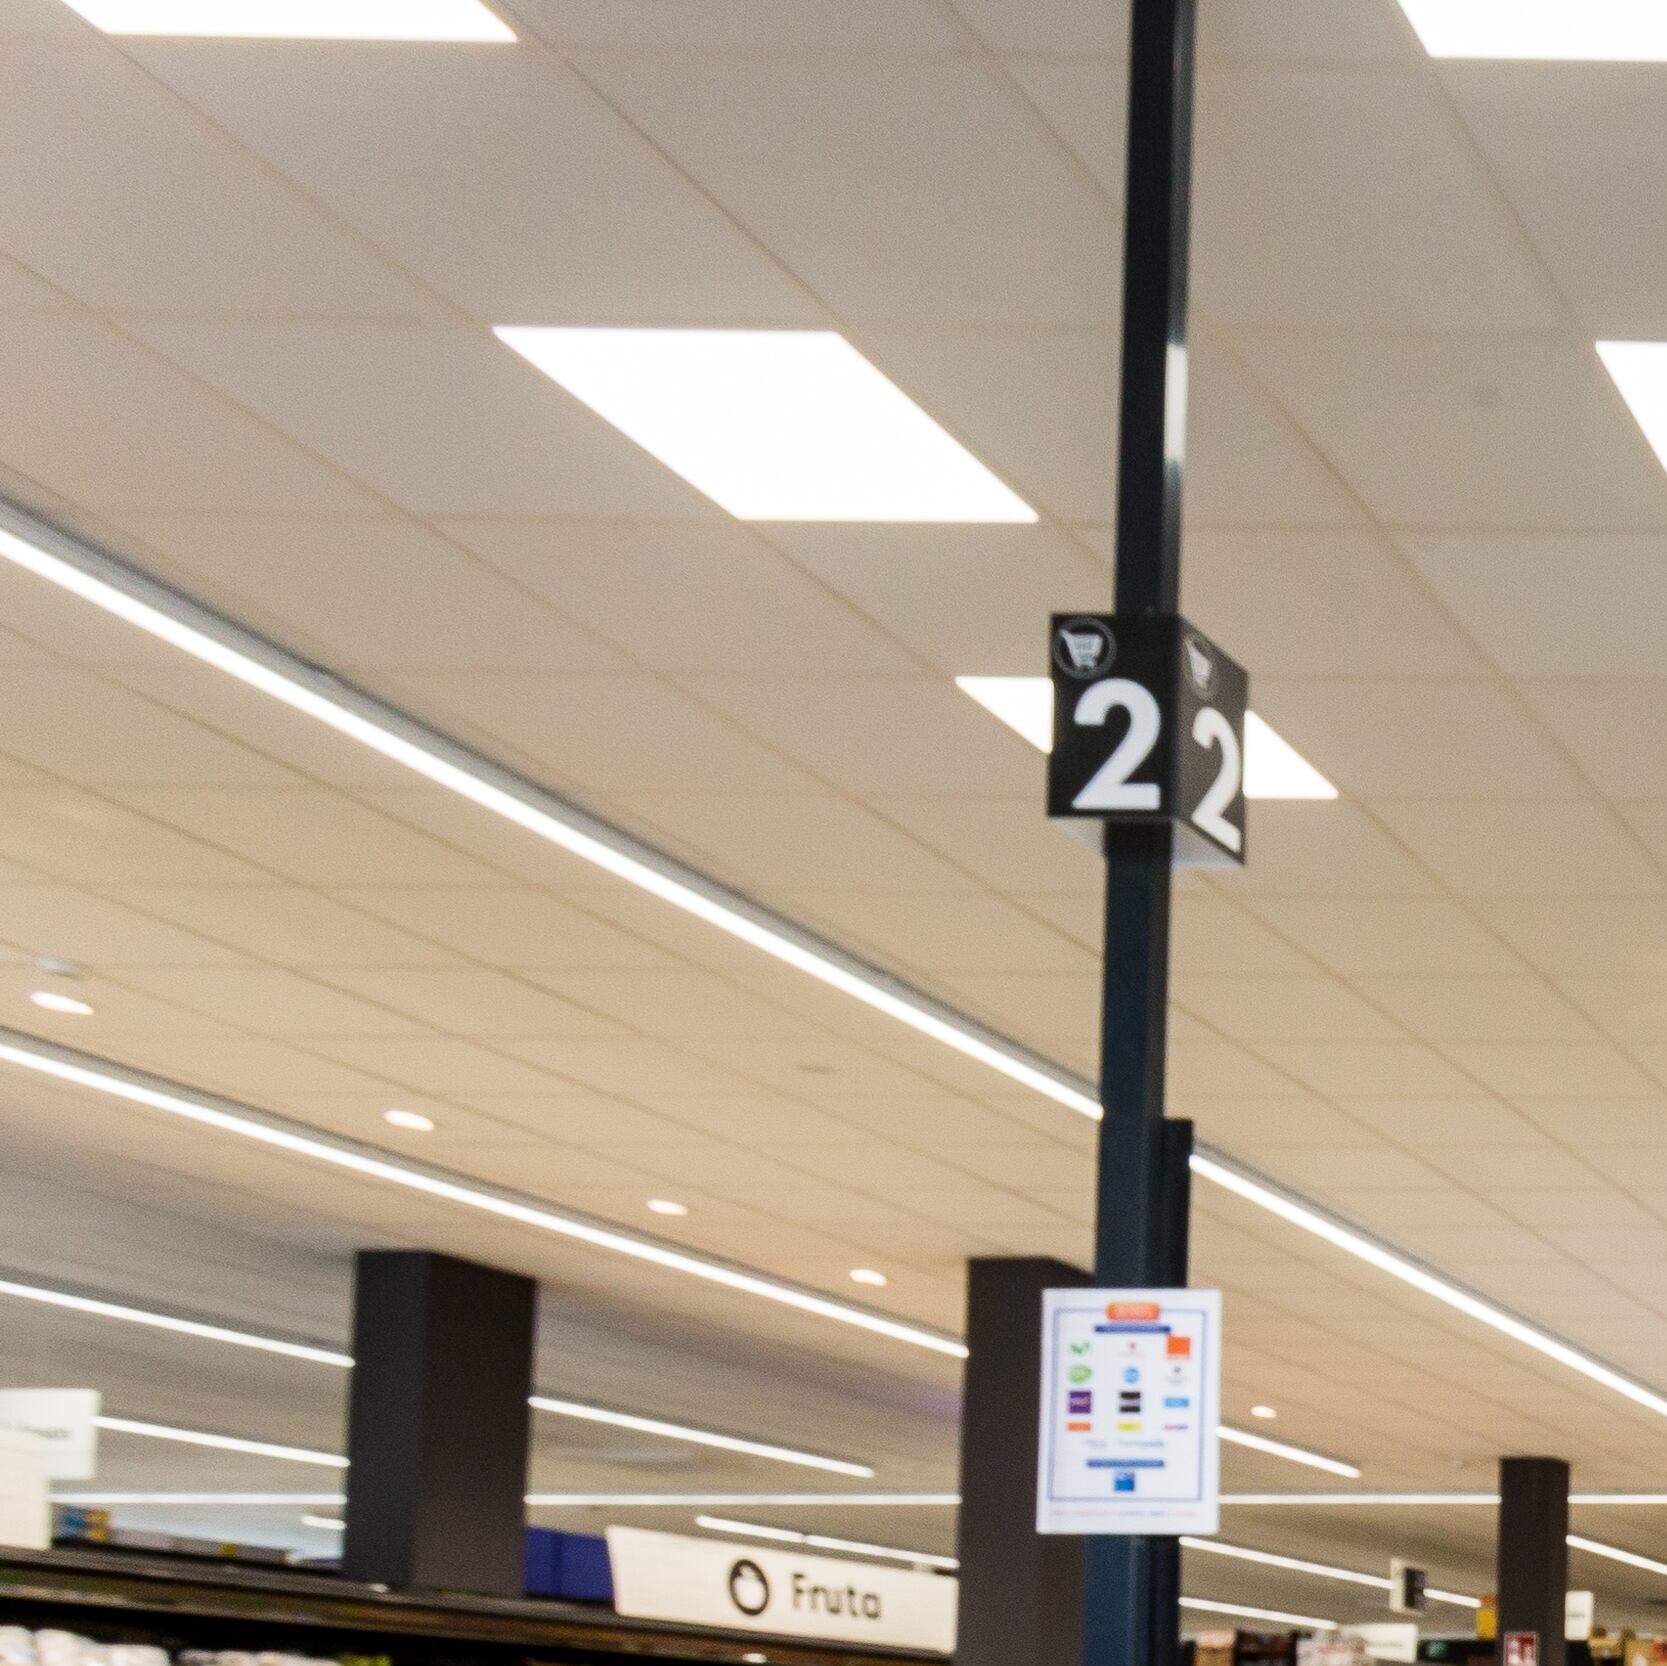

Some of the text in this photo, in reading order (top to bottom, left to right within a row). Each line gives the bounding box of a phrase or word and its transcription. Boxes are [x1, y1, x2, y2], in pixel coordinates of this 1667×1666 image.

[1071, 677, 1162, 811] 2
[1191, 706, 1242, 853] 2
[789, 1572, 882, 1620] Fruta
